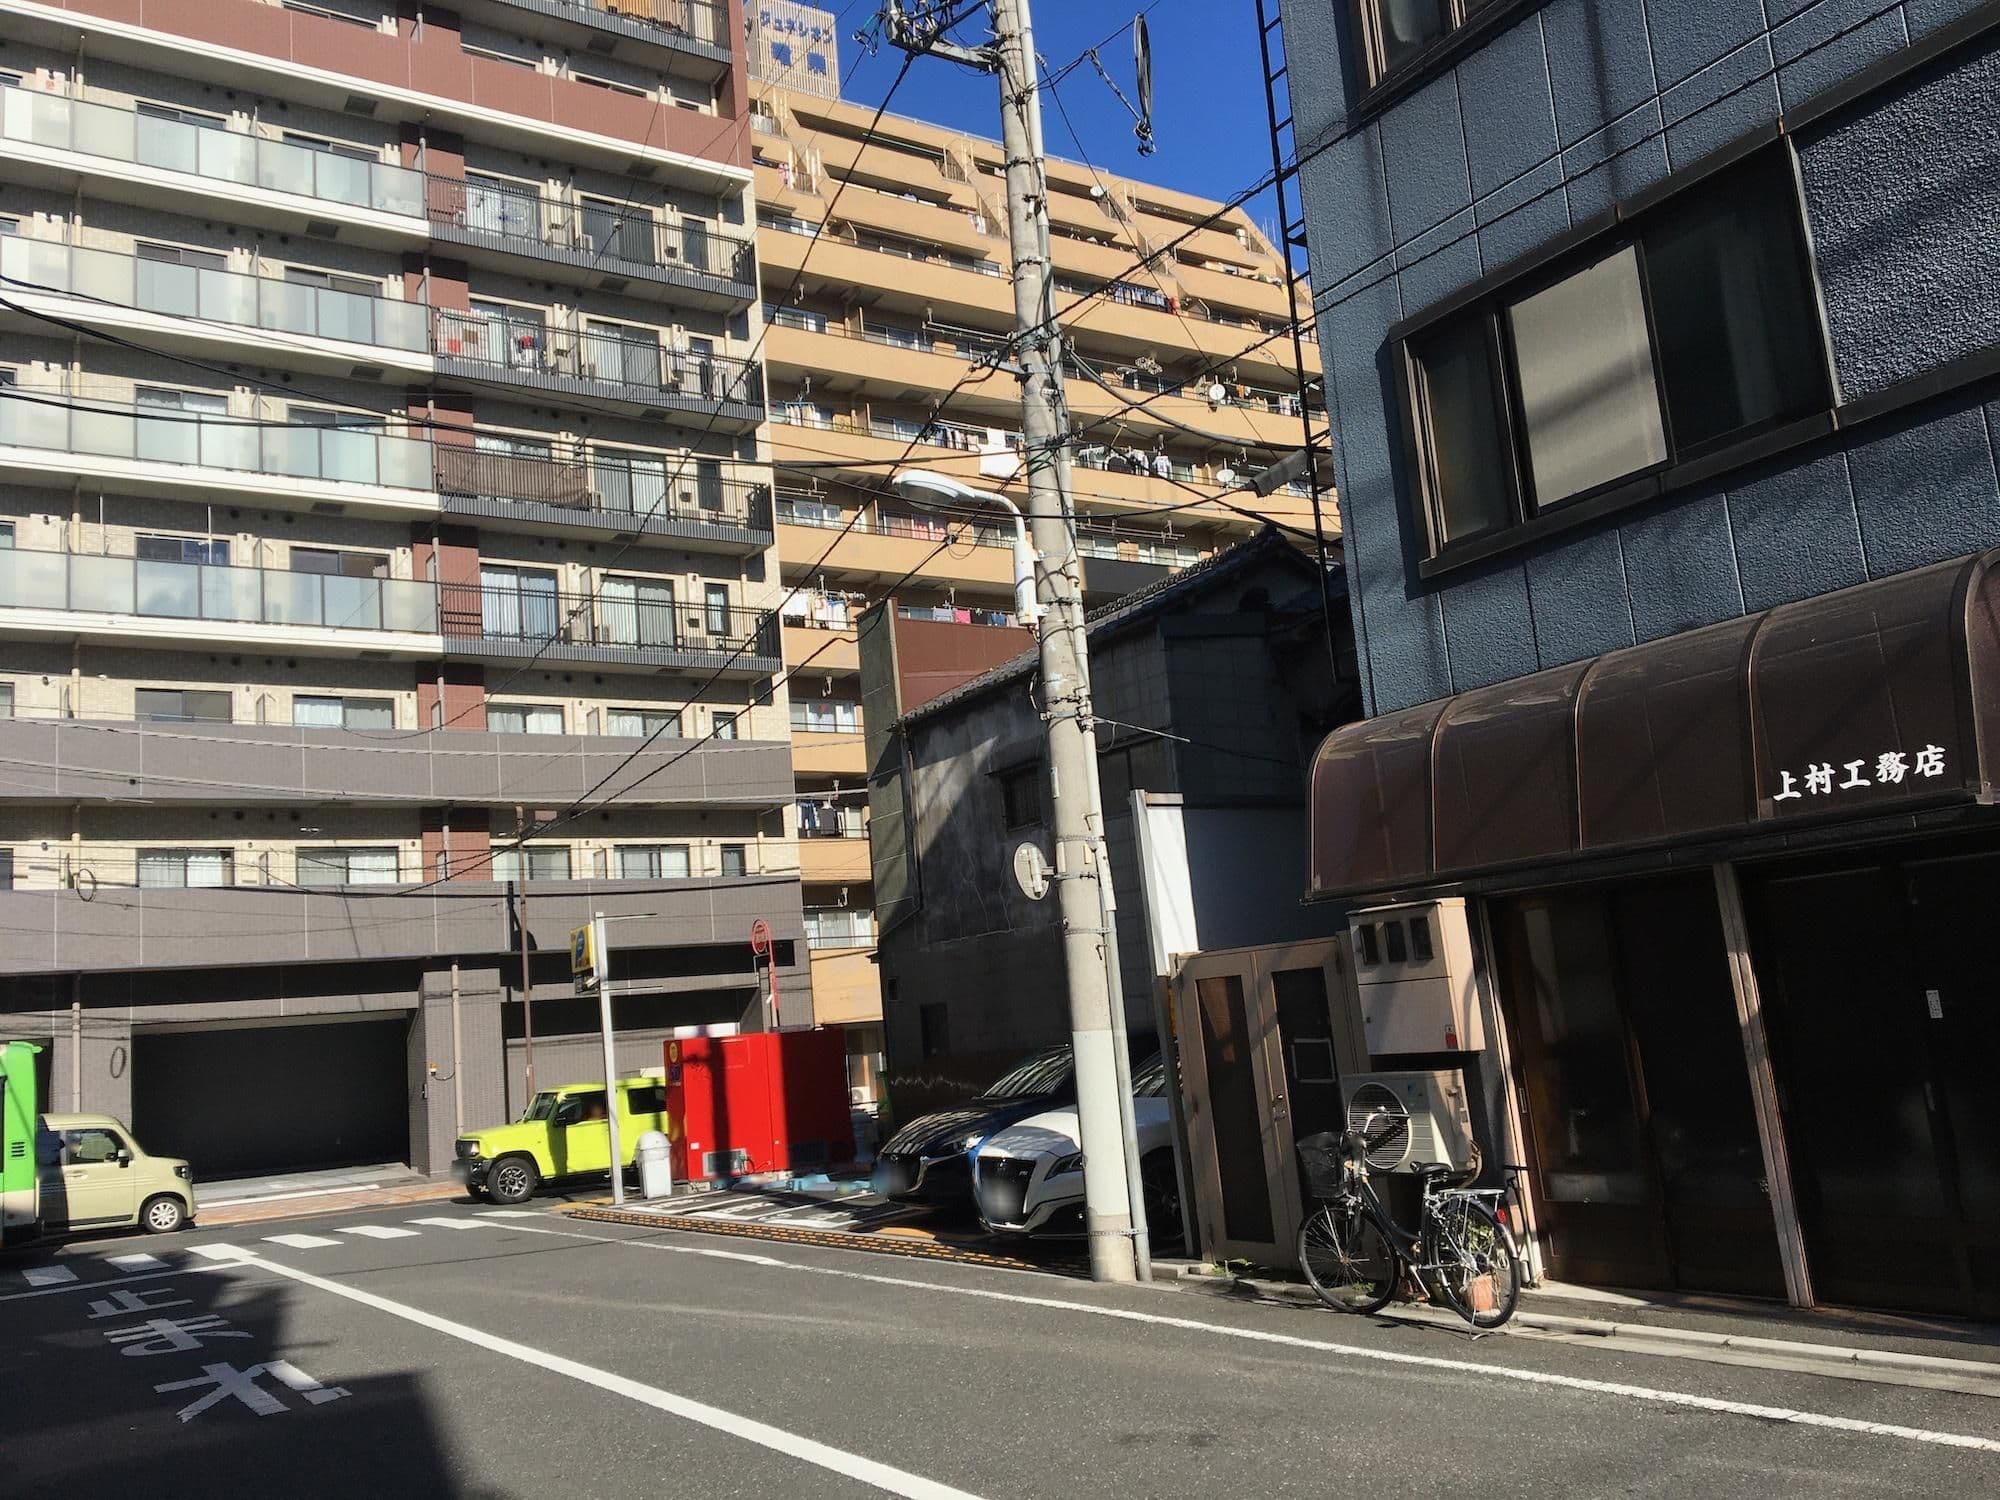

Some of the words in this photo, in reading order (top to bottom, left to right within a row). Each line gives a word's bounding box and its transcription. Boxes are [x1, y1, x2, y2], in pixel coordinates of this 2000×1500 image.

[1773, 744, 1947, 801] 上村工務店
[87, 1287, 352, 1423] 止まれ
